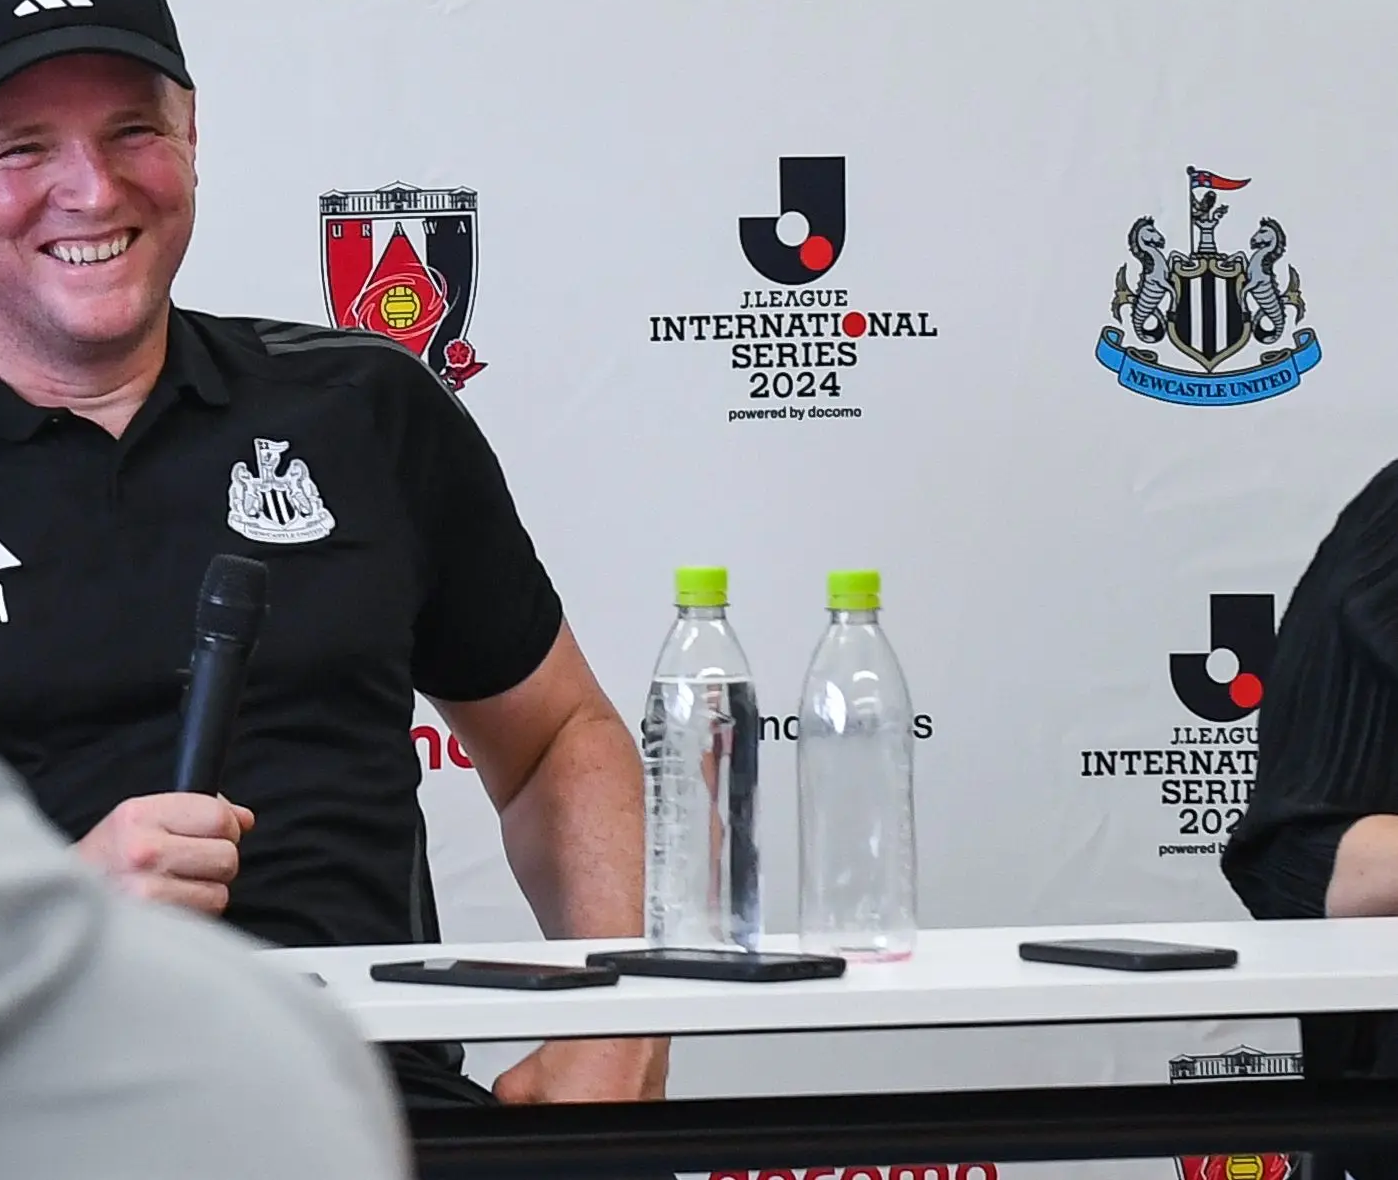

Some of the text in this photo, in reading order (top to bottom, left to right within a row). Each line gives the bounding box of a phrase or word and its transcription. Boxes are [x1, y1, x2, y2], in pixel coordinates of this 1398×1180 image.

[740, 289, 848, 309] J.LEAGUE
[732, 341, 858, 370] SERIES
[749, 371, 841, 399] 2024
[1126, 367, 1293, 398] NEWCASTLE UNITED
[728, 405, 862, 422] powered by docomo
[1170, 727, 1259, 745] J.LEAGU
[1081, 750, 1259, 777] INTERNAT
[1178, 808, 1245, 834] 202
[1159, 842, 1217, 857] powered
